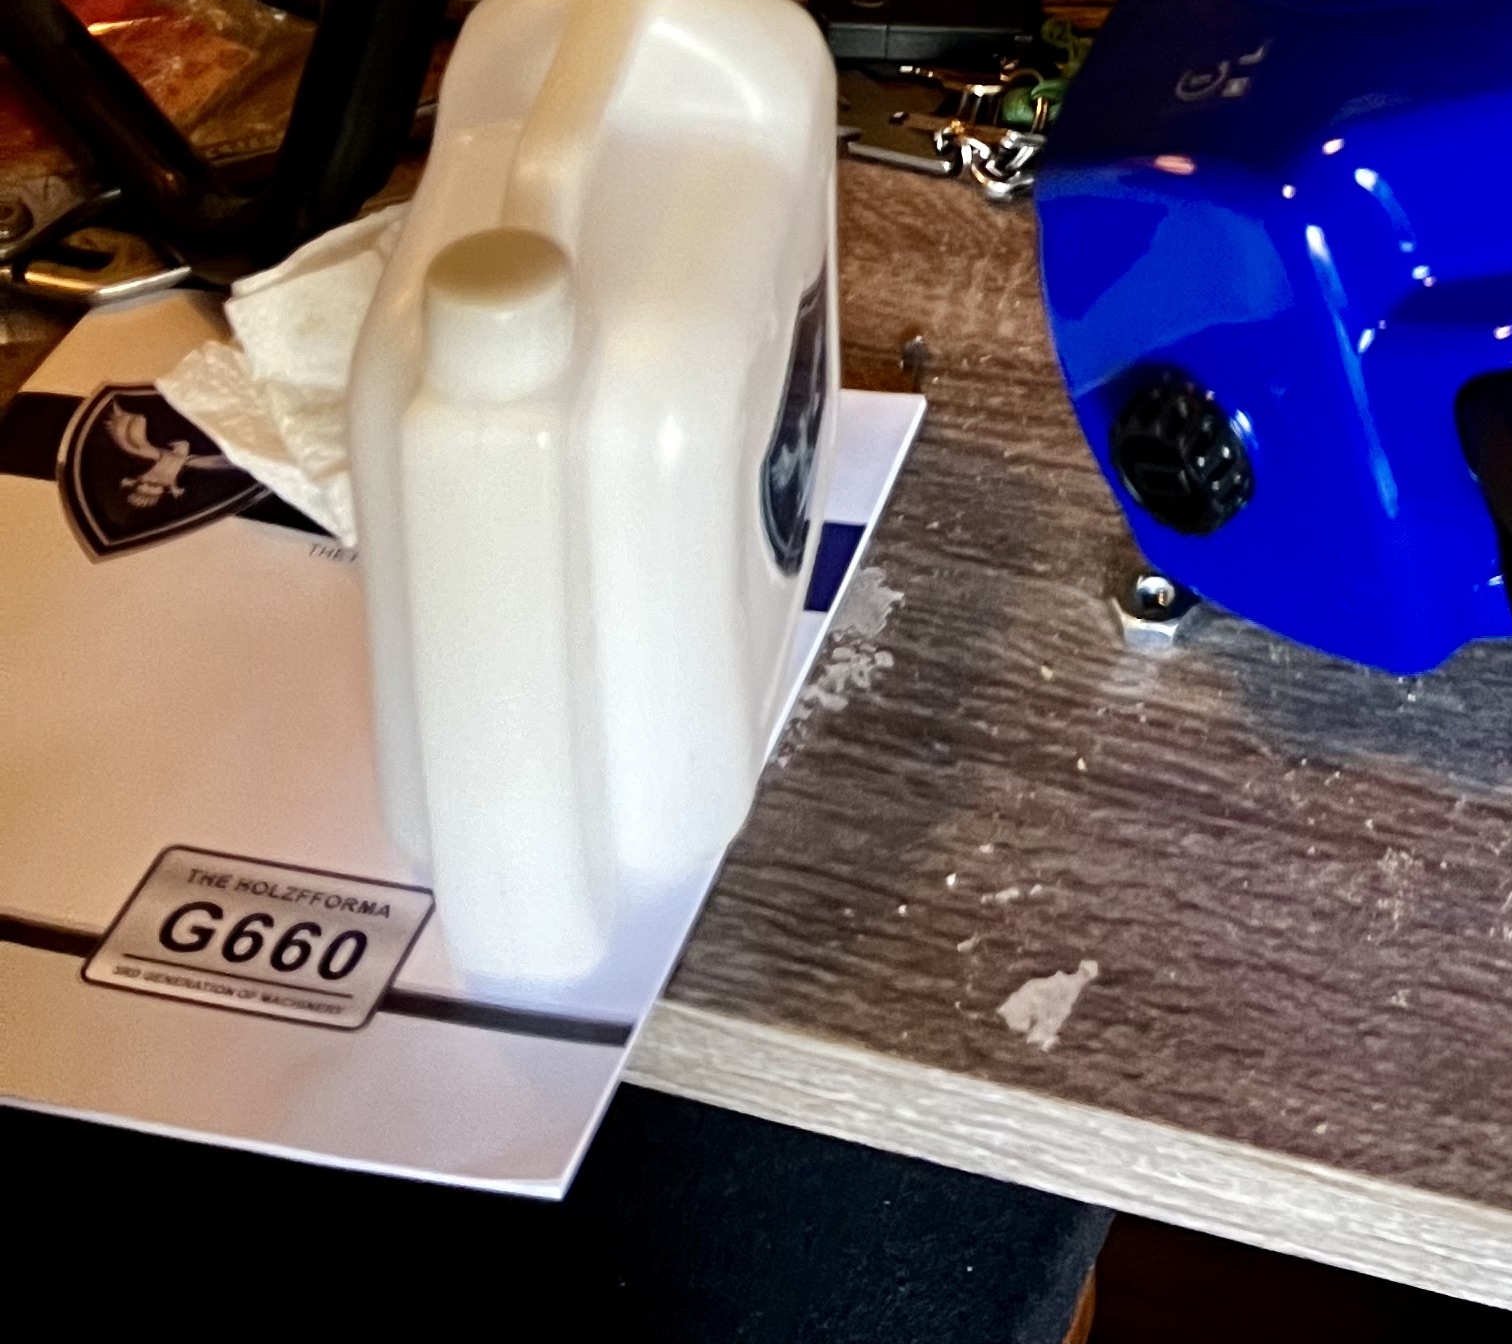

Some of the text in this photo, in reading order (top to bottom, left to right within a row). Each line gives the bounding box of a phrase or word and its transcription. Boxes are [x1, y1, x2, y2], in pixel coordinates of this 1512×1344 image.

[187, 868, 391, 919] THE HOLZFFORMA
[158, 900, 369, 981] G660
